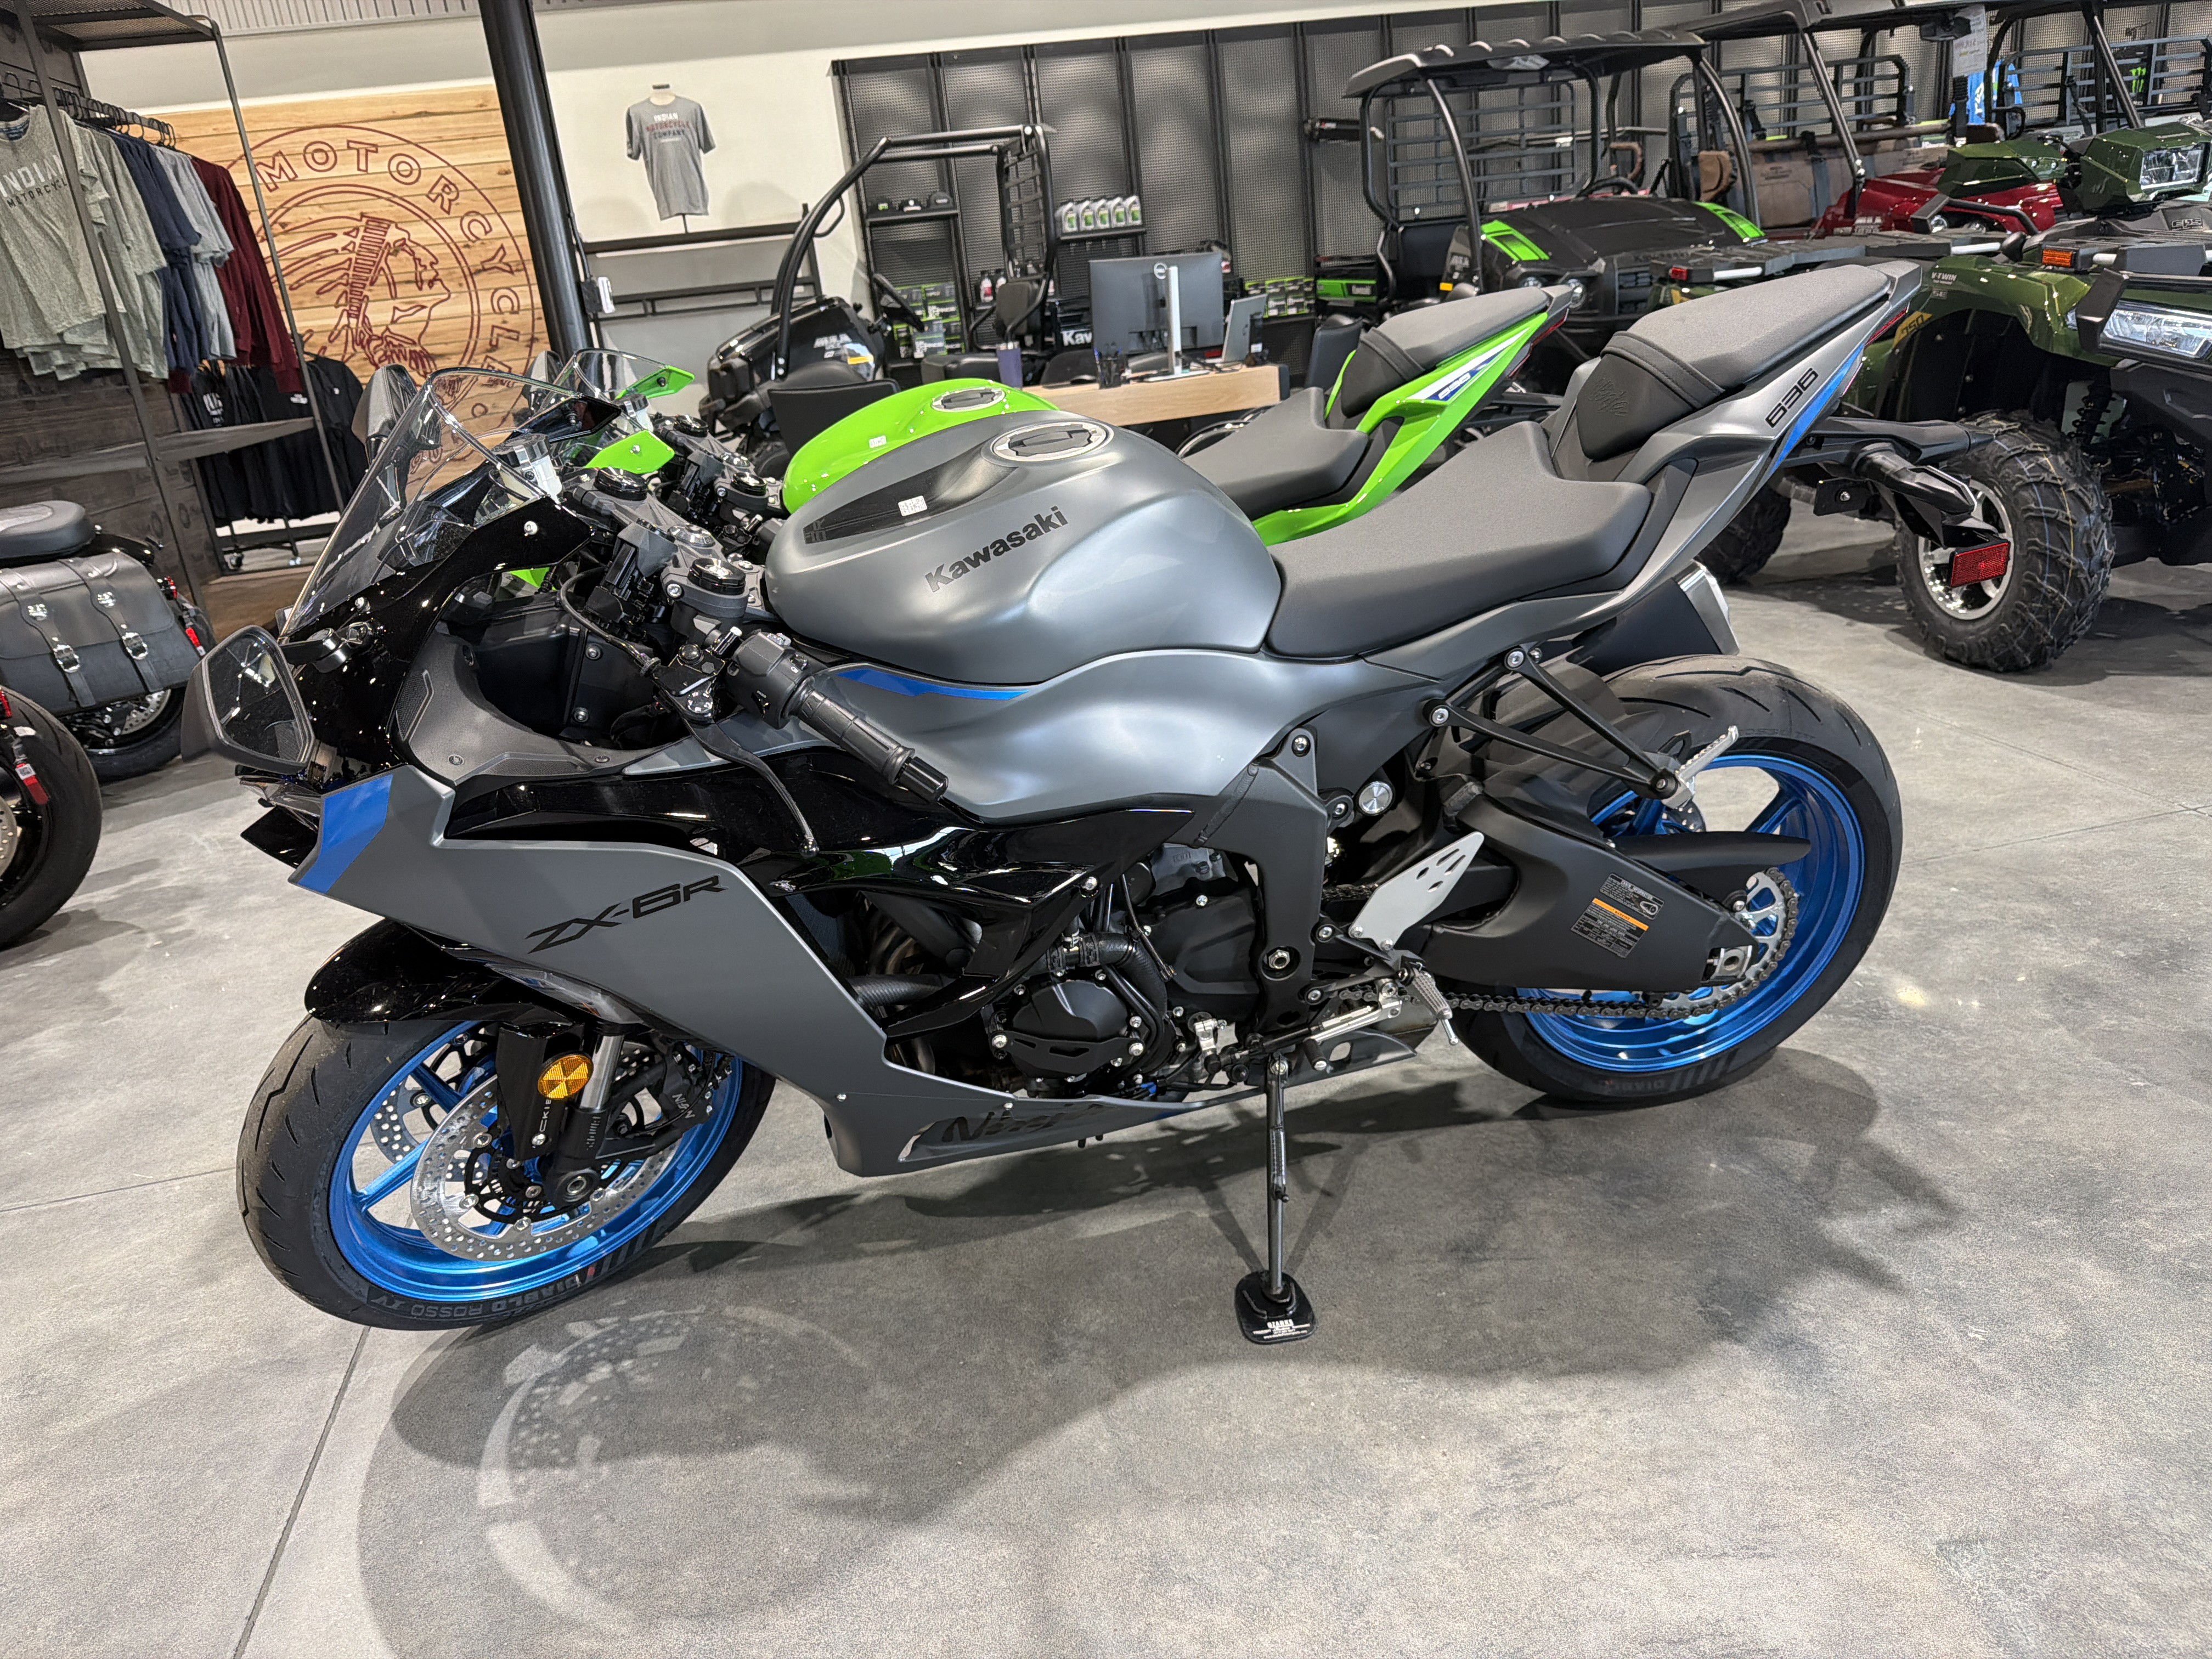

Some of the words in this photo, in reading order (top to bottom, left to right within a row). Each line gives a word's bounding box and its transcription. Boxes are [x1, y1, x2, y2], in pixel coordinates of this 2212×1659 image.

[7, 178, 67, 208] MOTORCYCL
[1931, 272, 1957, 281] V-TWIN
[1764, 368, 1819, 428] 636
[924, 506, 1069, 592] Kawasaki
[525, 874, 729, 955] ZX-6R
[410, 1303, 483, 1318] ROSSO
